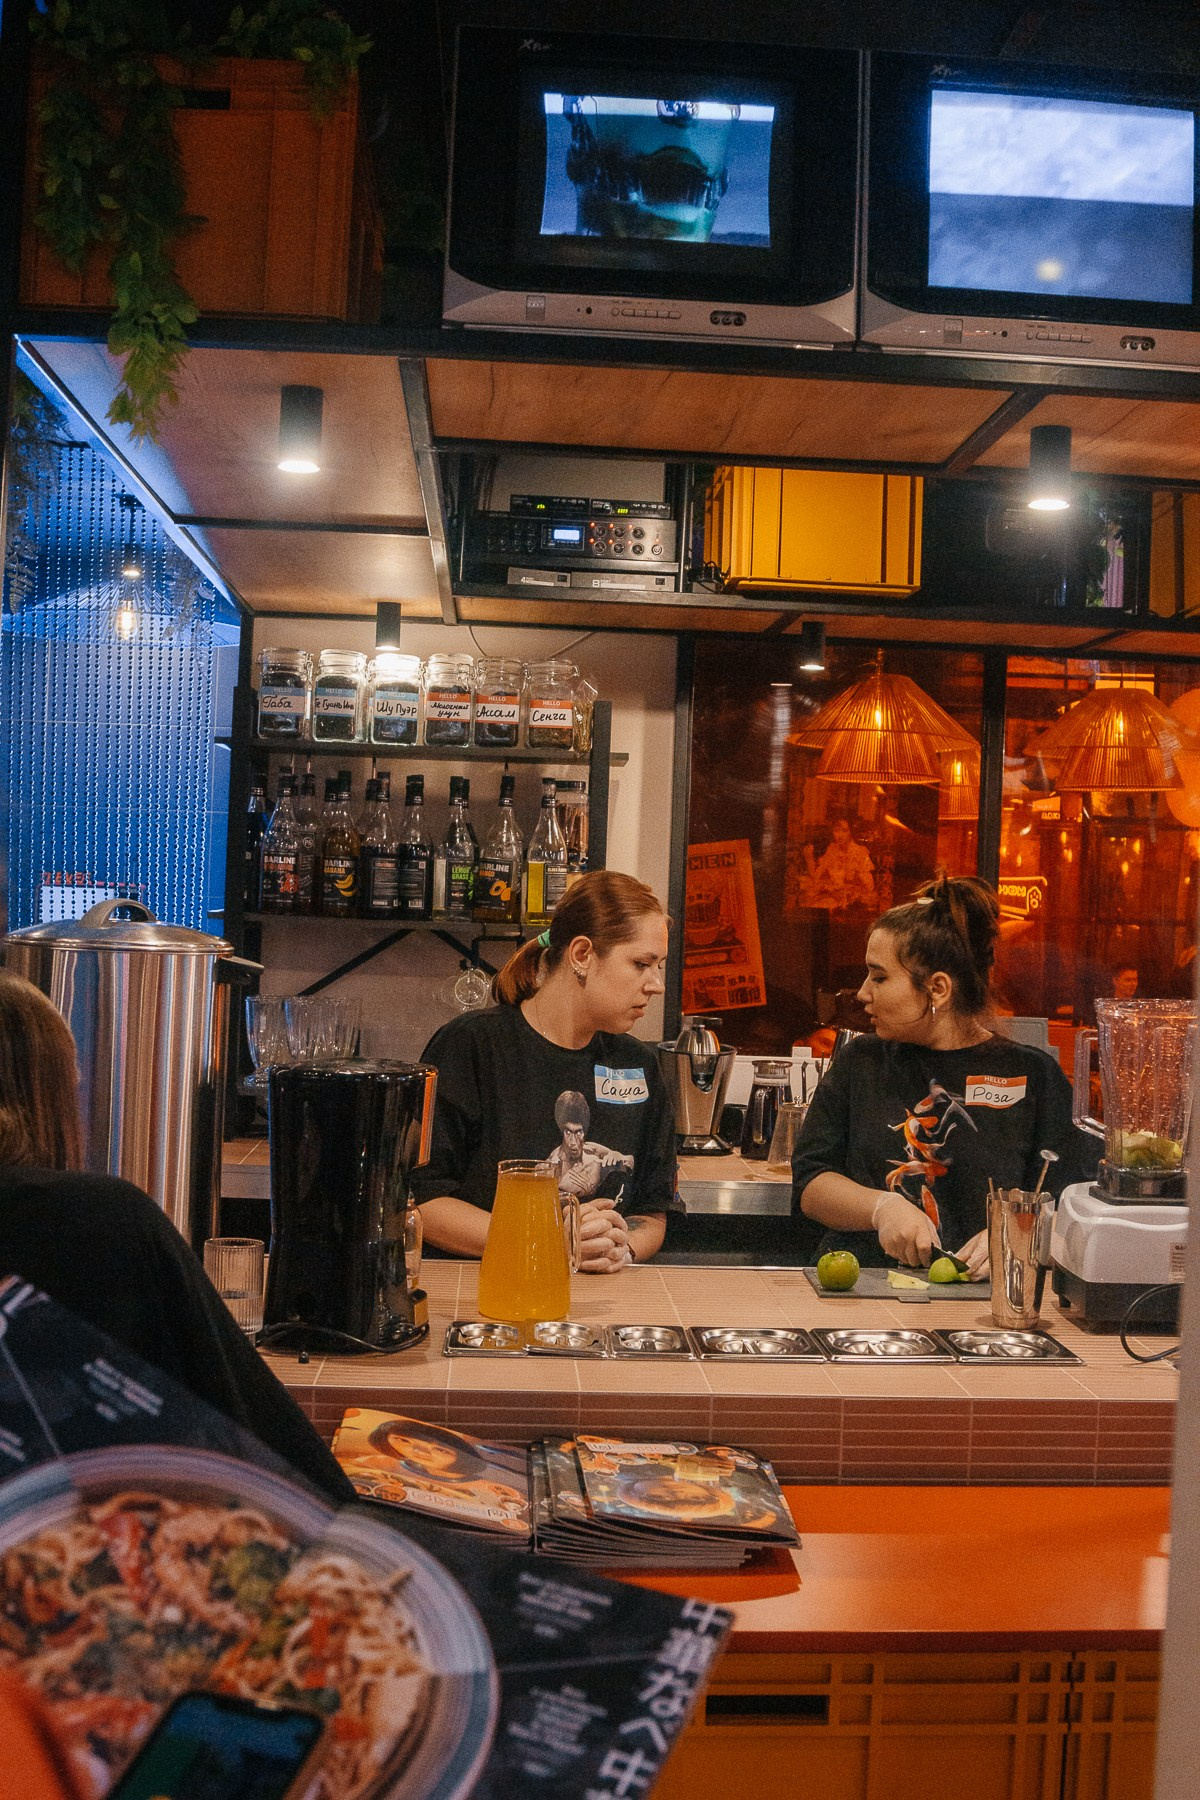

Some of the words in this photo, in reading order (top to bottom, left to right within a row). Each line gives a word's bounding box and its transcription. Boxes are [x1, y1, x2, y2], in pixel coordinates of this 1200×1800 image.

[263, 695, 293, 708] Габа
[376, 701, 394, 715] Шу
[395, 703, 417, 717] Пуэр
[476, 705, 516, 718] Ассам
[532, 709, 567, 722] Сенча
[264, 855, 296, 864] BARLINE
[984, 1076, 1008, 1085] HELLO
[601, 1078, 646, 1098] Саша
[972, 1086, 1015, 1103] Роза
